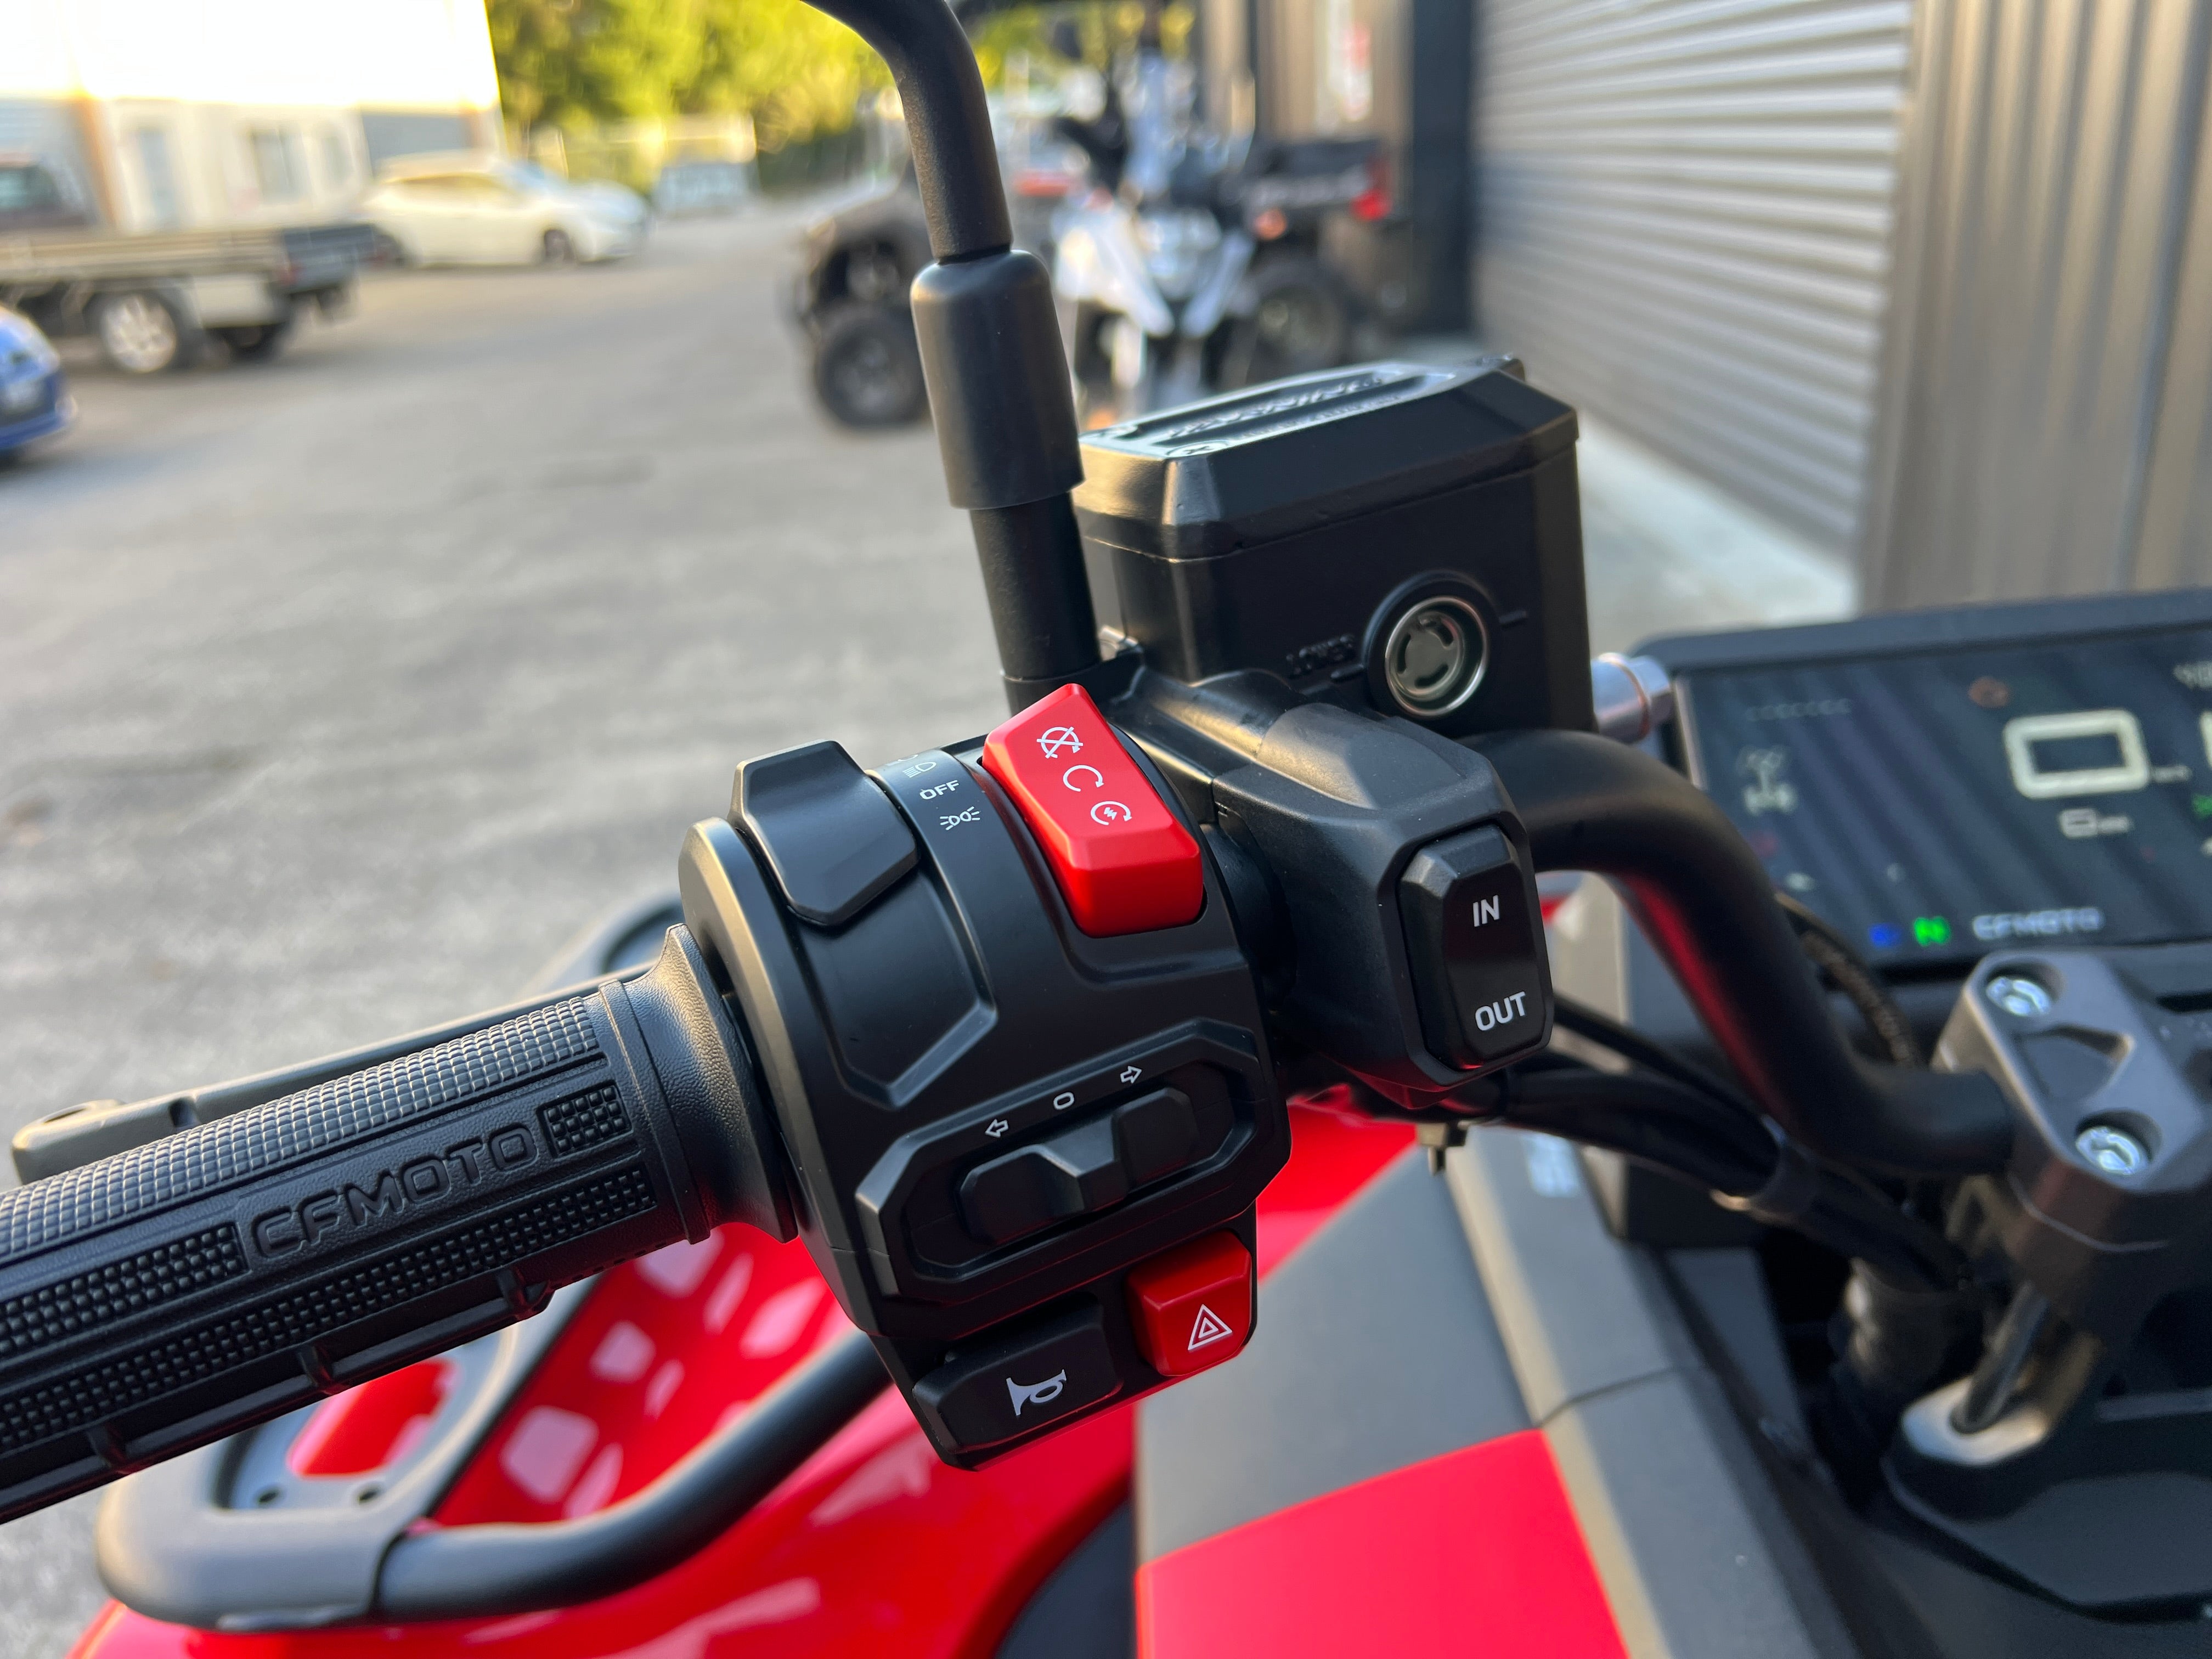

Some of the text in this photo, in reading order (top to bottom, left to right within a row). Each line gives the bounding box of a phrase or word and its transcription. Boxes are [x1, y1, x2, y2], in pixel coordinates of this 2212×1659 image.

[919, 780, 960, 800] OFF
[1472, 894, 1500, 927] IN
[1475, 991, 1526, 1031] OUT
[251, 1122, 539, 1260] CFMOTO
